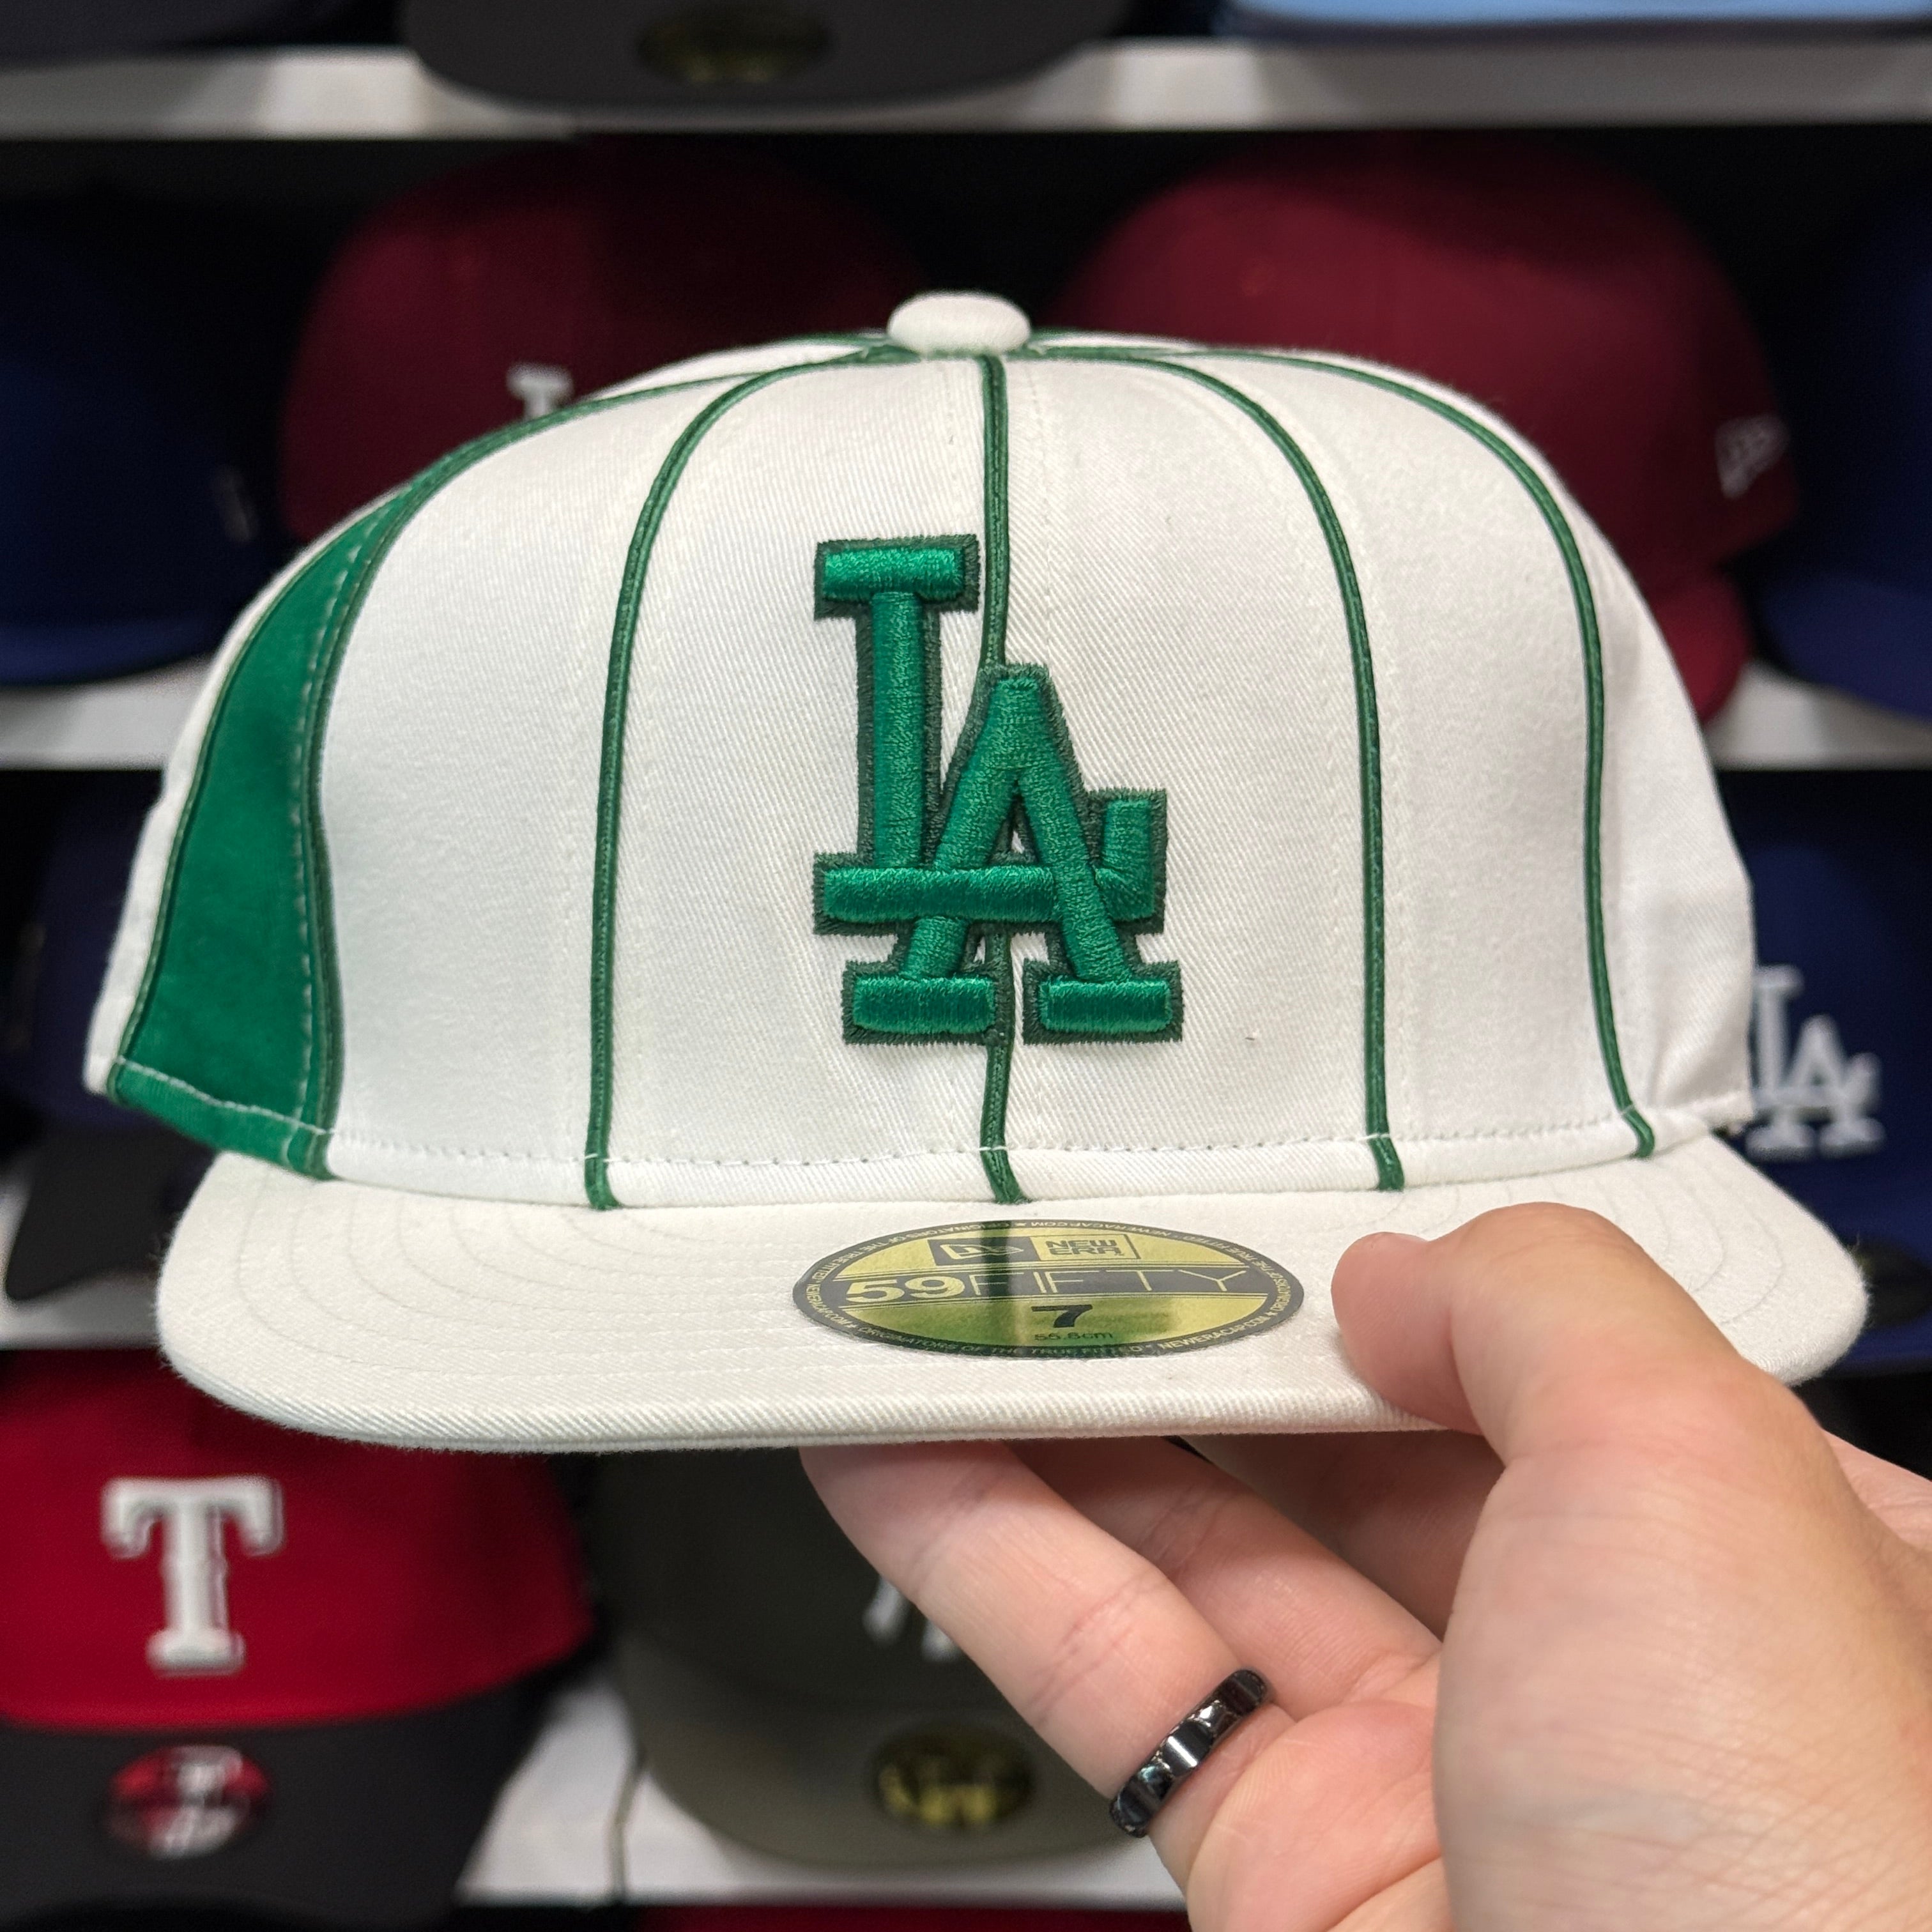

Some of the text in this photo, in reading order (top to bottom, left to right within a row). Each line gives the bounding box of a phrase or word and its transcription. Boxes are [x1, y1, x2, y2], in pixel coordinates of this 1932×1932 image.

[813, 533, 1183, 1046] LA
[1746, 963, 1885, 1160] LA
[1045, 1239, 1117, 1248] NEW
[1049, 1246, 1123, 1255] ERA
[1031, 1304, 1093, 1328] 7
[101, 1473, 286, 1679] T
